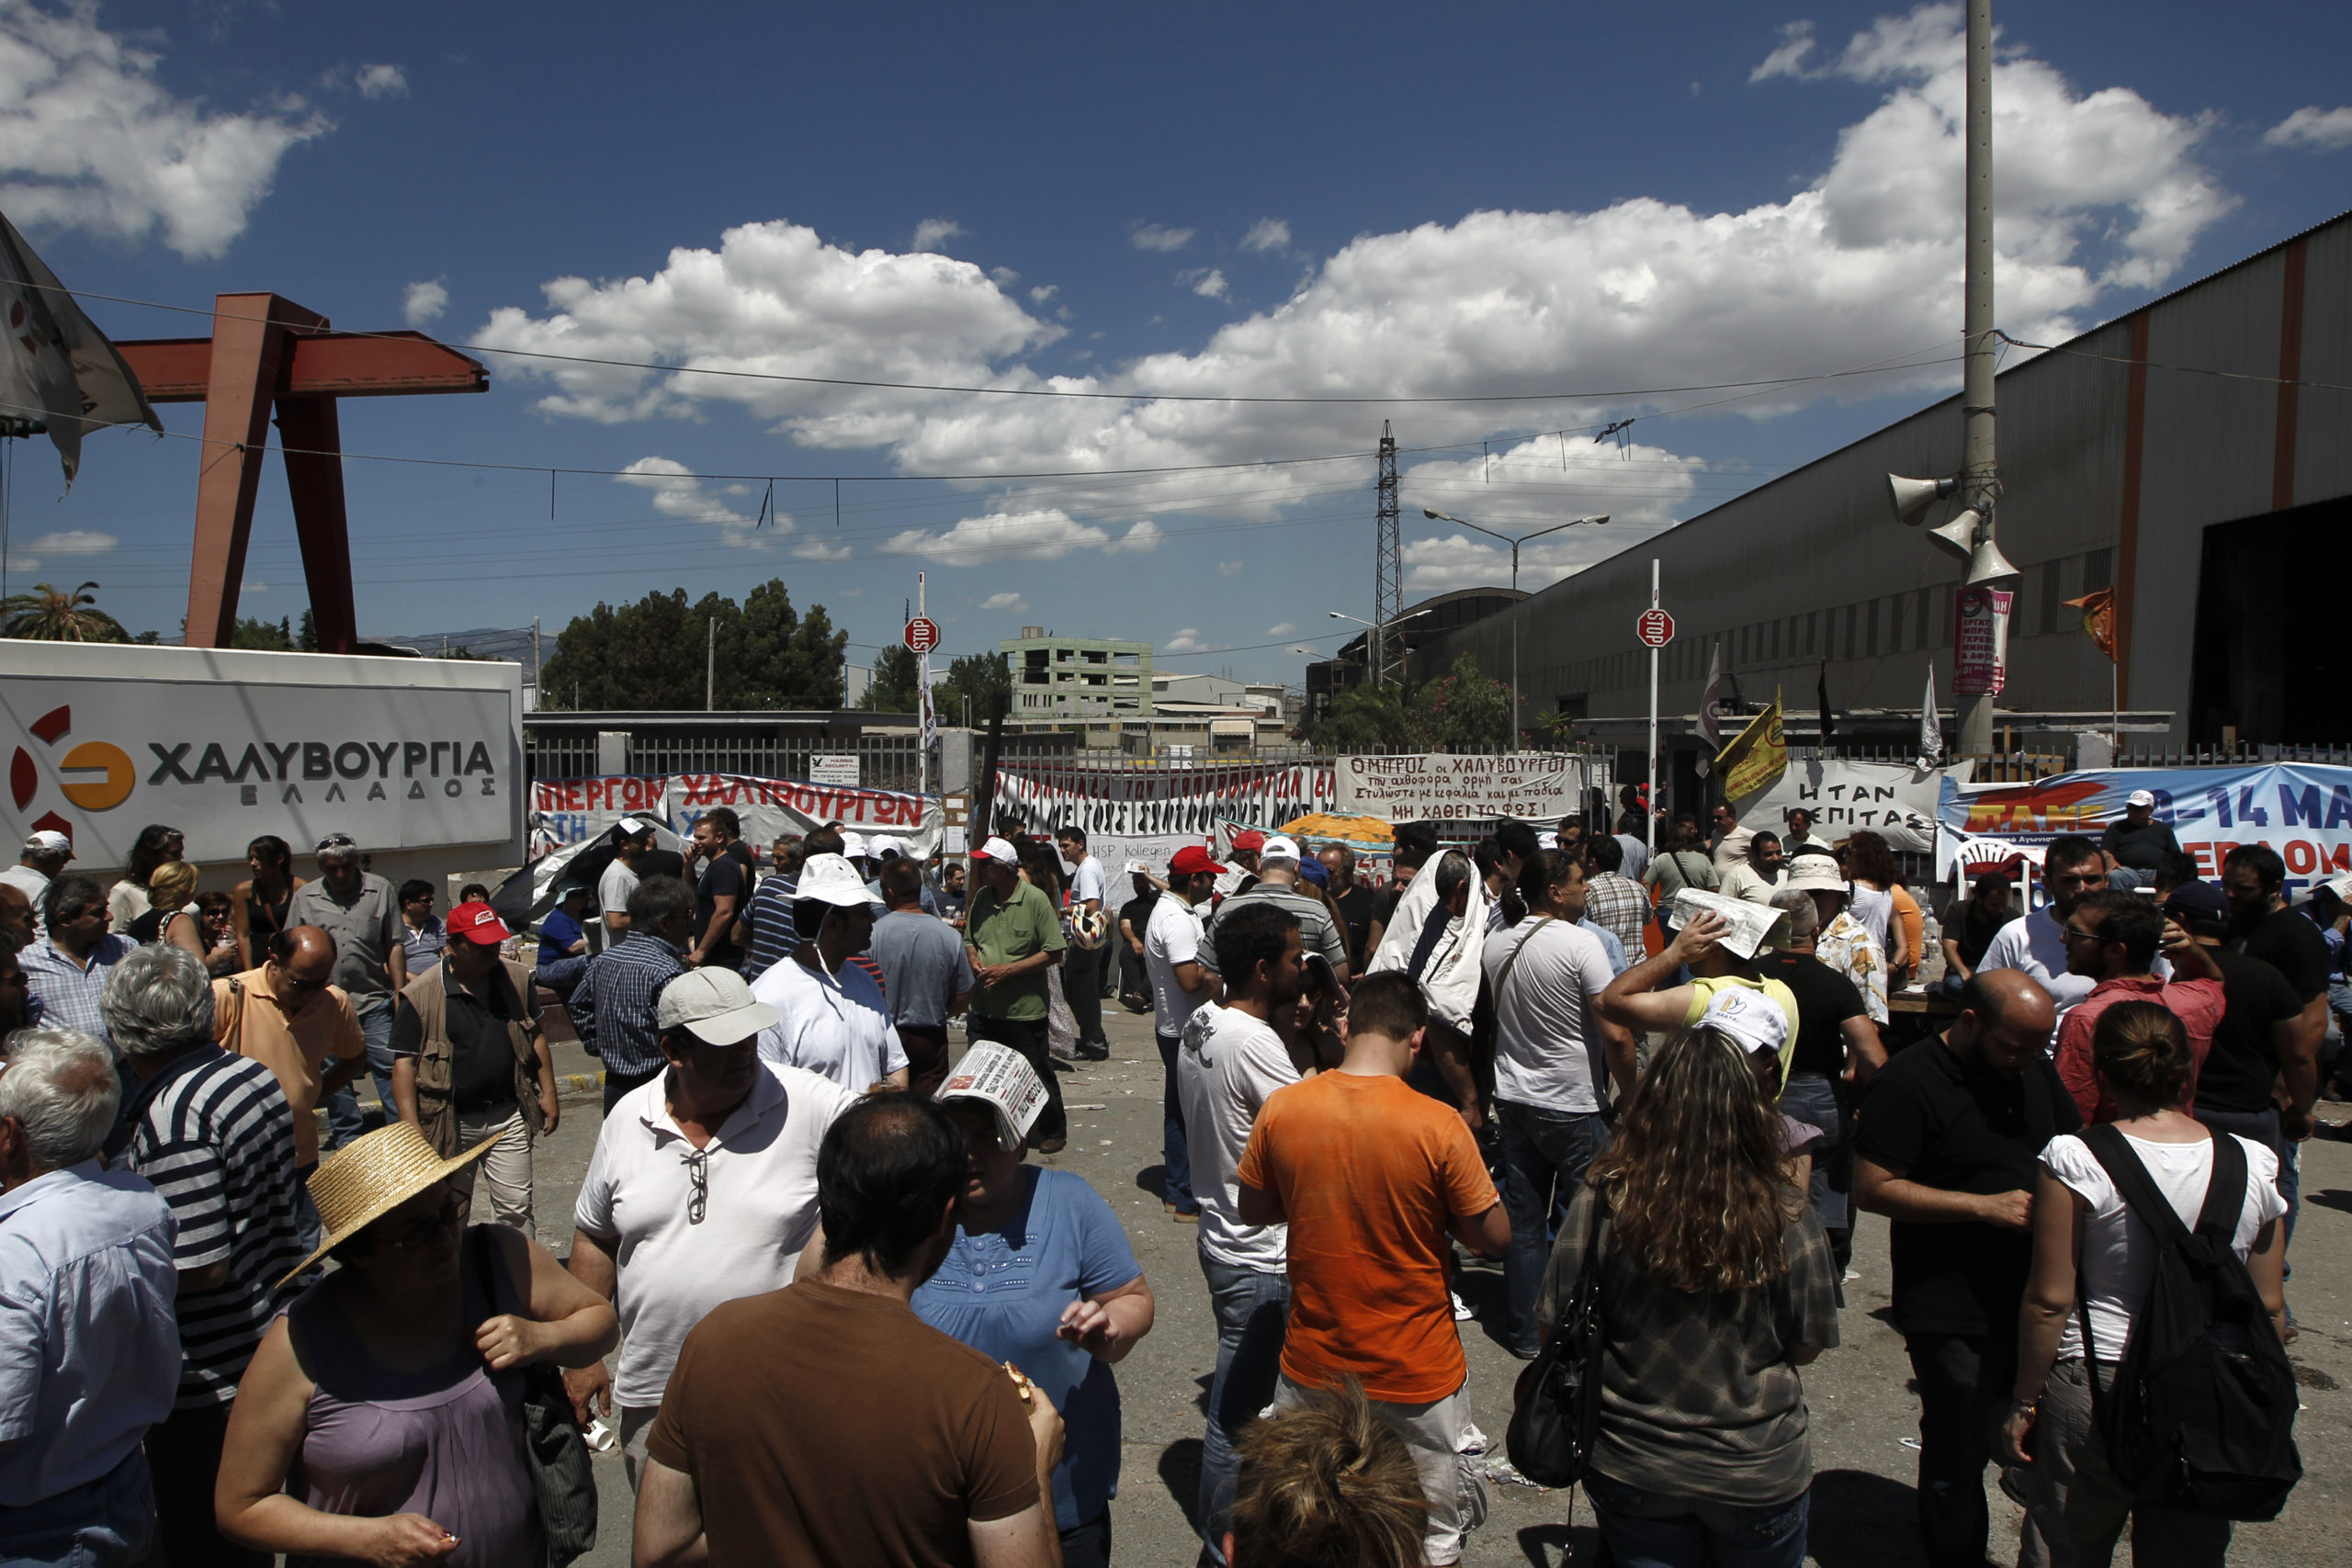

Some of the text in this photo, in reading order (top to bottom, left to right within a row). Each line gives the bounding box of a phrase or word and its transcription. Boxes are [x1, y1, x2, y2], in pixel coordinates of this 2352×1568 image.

[913, 621, 929, 649] STOP
[1646, 613, 1664, 643] STOP
[147, 741, 494, 785] ΧΑΛΥΒΟΥΡΓΙΑ
[241, 778, 496, 806] ΕΛΛΑΔΟΣ
[1392, 805, 1414, 819] ΜΗ
[1421, 804, 1471, 818] ΧΑΘΕΙ
[1125, 844, 1170, 861] Kollegen
